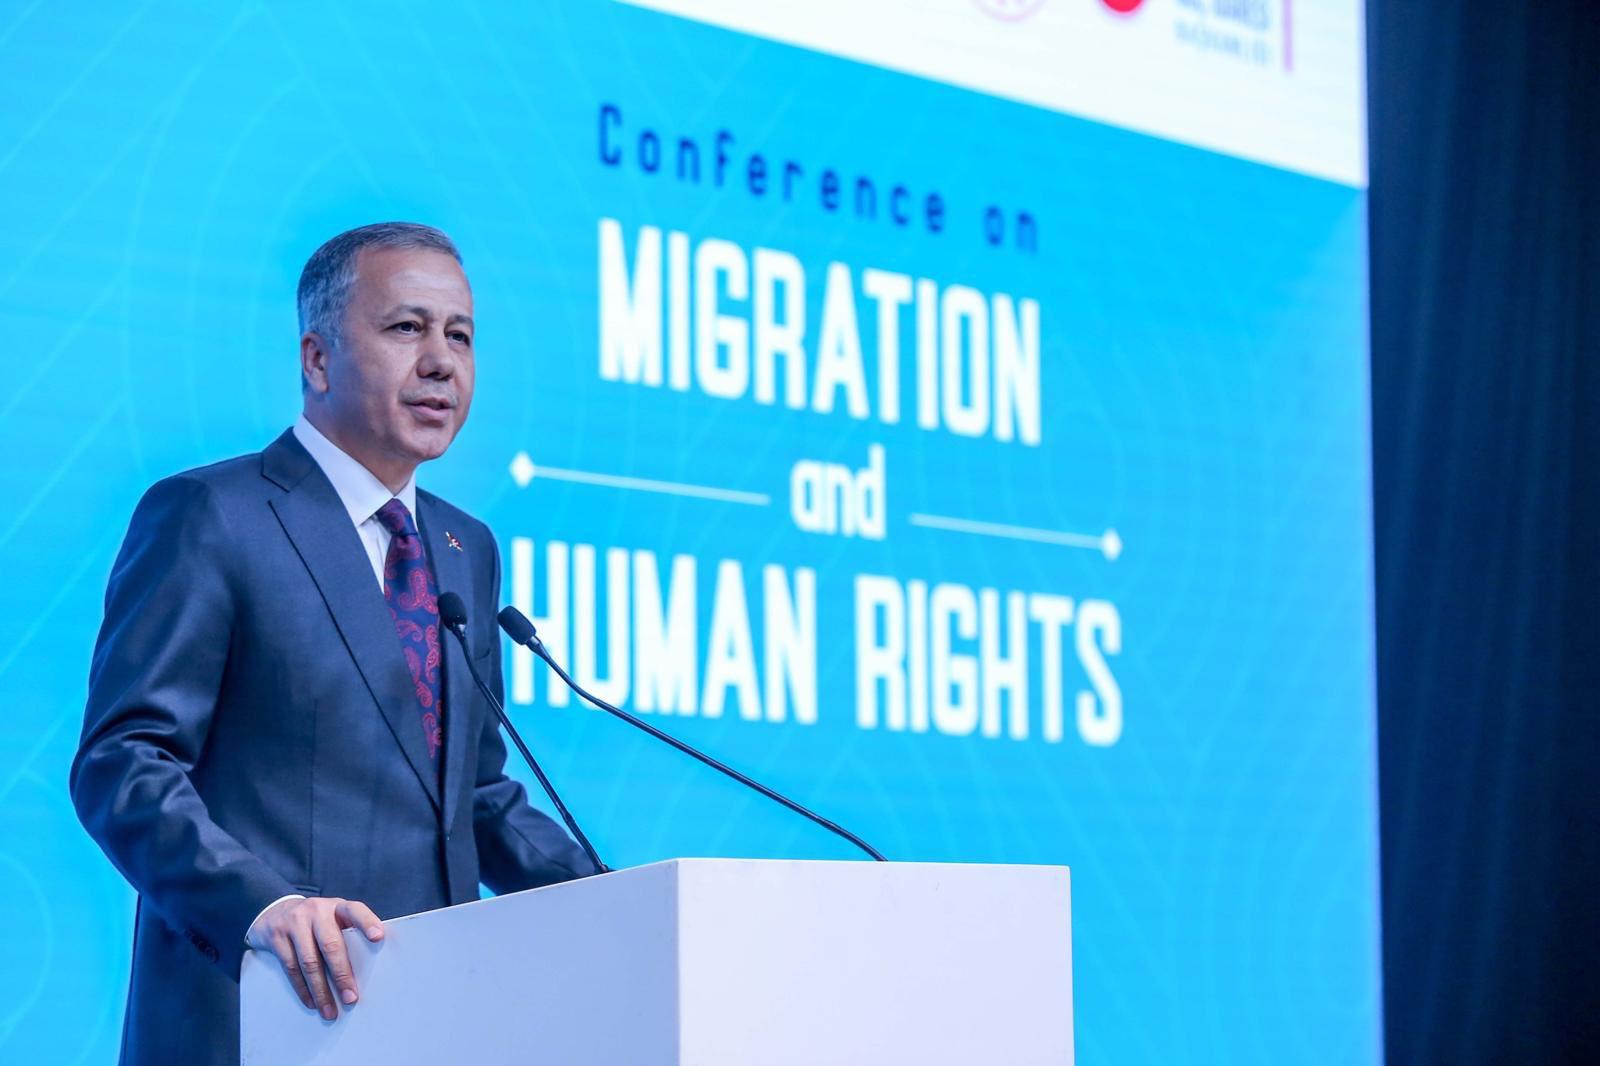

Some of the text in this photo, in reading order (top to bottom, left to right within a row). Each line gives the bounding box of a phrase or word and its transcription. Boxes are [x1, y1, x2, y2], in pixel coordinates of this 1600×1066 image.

[598, 103, 1039, 255] Conference on
[598, 217, 1042, 447] MIGRATION
[790, 443, 886, 539] and
[511, 536, 1123, 746] HUMAN RIGHTS
